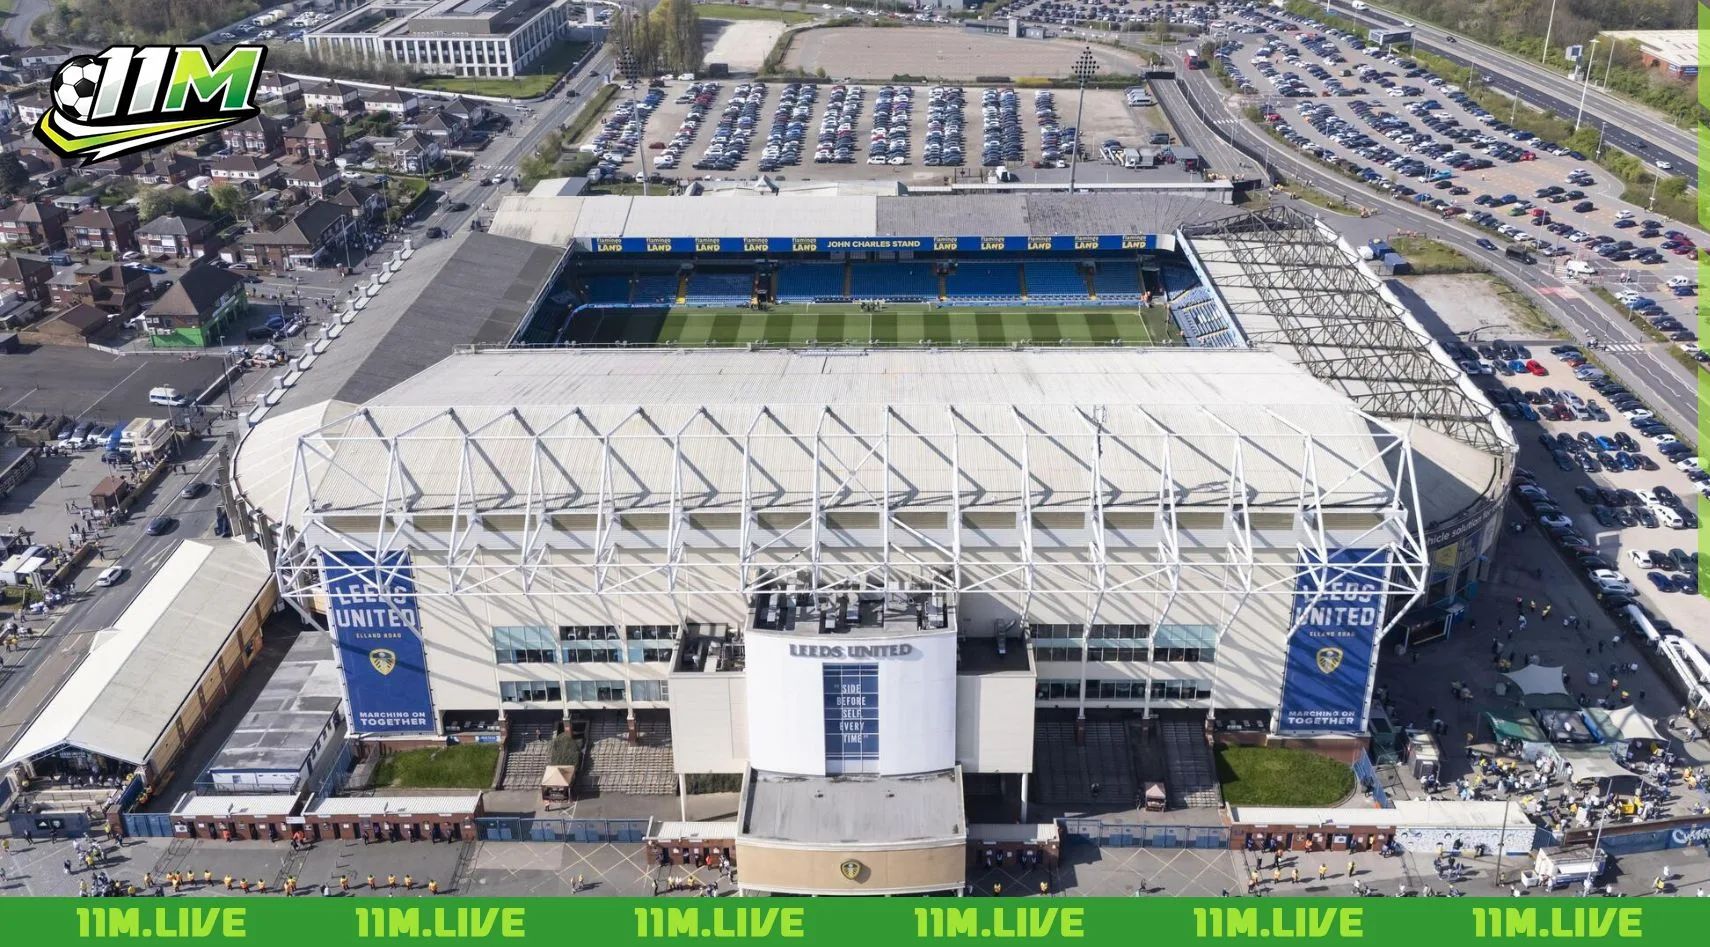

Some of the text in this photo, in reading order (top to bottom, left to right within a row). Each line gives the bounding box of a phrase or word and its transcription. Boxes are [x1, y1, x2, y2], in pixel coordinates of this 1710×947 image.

[598, 244, 623, 252] LAND
[647, 244, 672, 252] LAND
[695, 244, 720, 252] LAND
[744, 244, 769, 252] LAND
[793, 244, 817, 252] LAND
[827, 240, 920, 248] JOHN CHARLES STAND
[934, 243, 957, 251] LAND
[1028, 242, 1051, 250] LAND
[1122, 241, 1146, 249] LAND
[335, 608, 416, 628] UNITED
[1296, 607, 1375, 626] UNITED
[789, 643, 913, 658] LEEDS UNITED
[836, 696, 866, 706] BEFORE
[361, 718, 427, 726] TOGETHER
[1288, 717, 1354, 725] TOGETHER
[840, 721, 865, 731] EVERY
